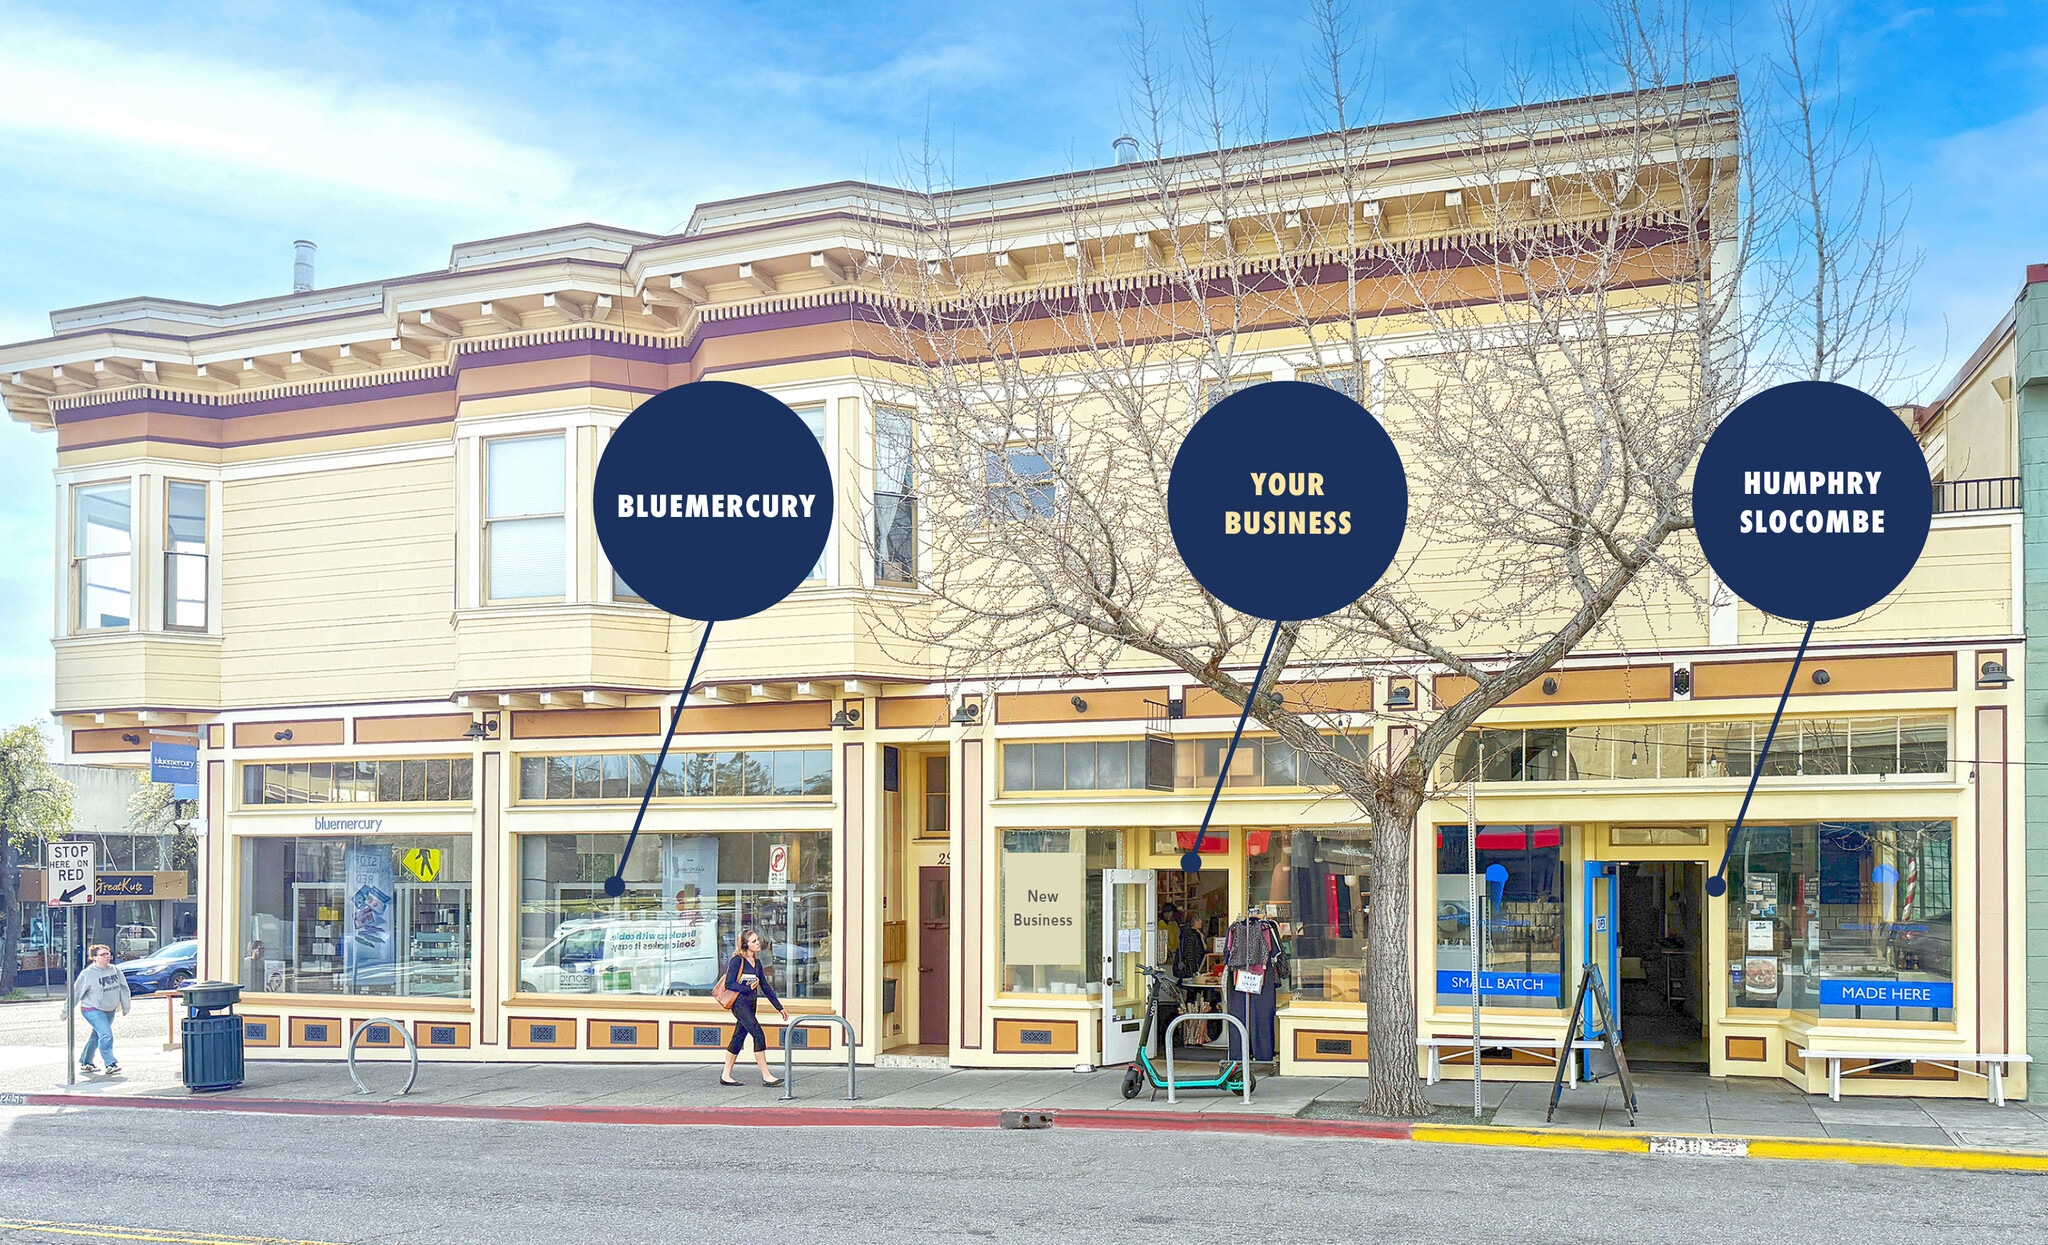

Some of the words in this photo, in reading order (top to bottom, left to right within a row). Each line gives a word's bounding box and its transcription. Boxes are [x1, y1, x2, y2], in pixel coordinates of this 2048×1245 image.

[314, 816, 383, 832] bluemercury
[54, 845, 89, 859] STOP
[50, 860, 71, 869] HERE
[77, 859, 89, 868] ON
[58, 869, 84, 881] RED
[1028, 889, 1059, 903] New
[1013, 913, 1073, 926] Business
[1497, 978, 1544, 990] BATCH
[1842, 986, 1887, 1000] MADE
[1891, 988, 1931, 1001] HERE
